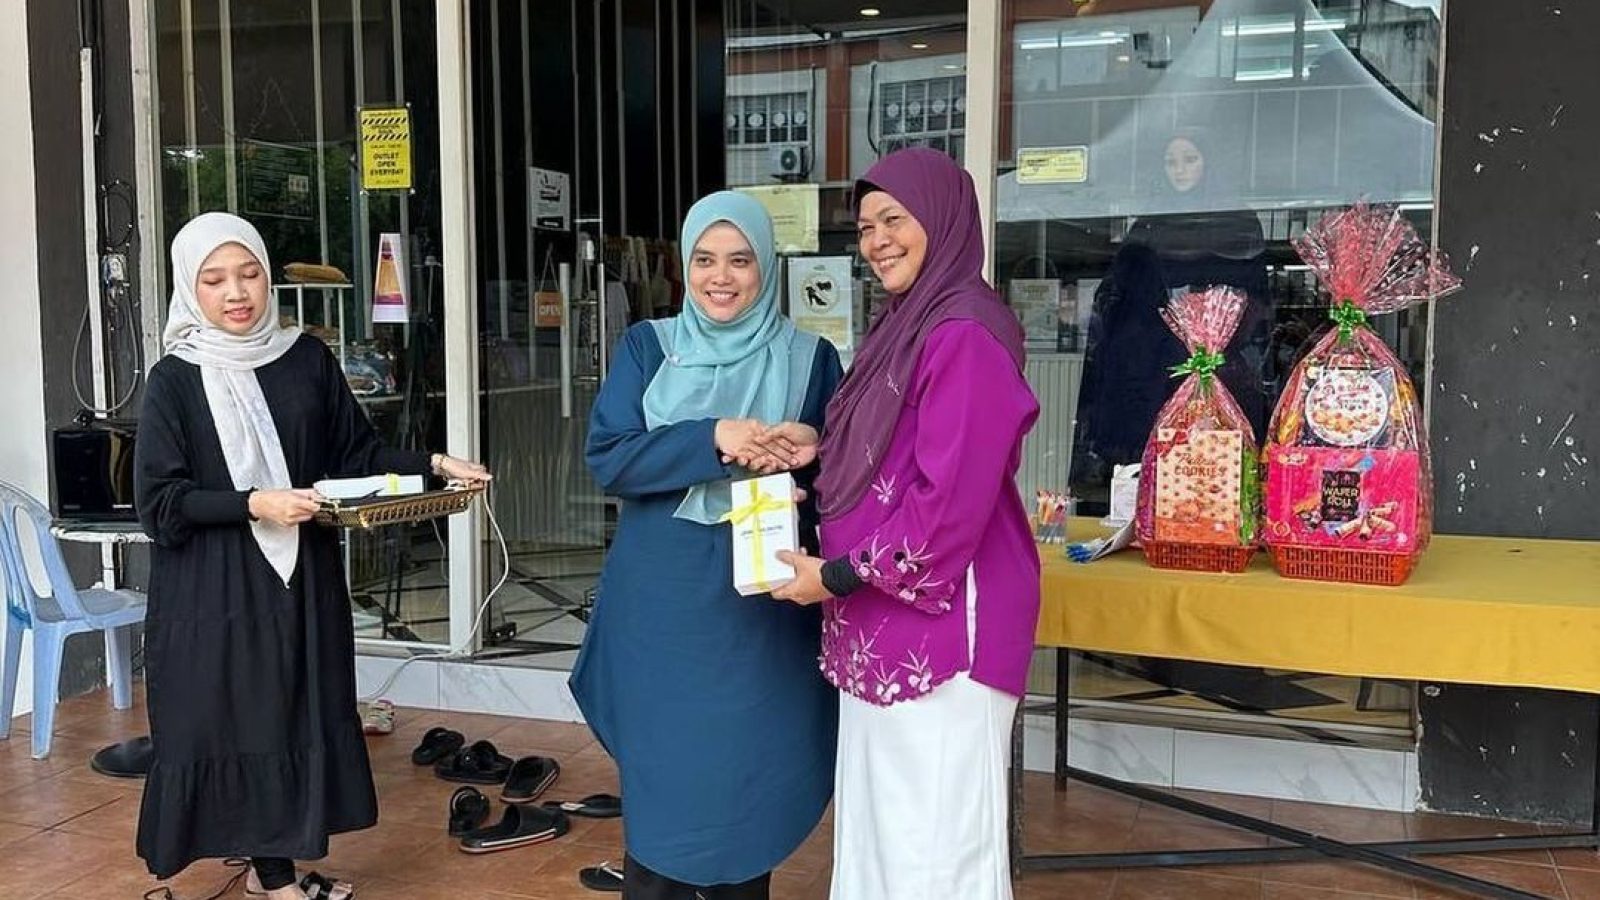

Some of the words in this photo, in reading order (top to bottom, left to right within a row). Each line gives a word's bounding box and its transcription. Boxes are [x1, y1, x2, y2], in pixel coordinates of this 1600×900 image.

[373, 153, 400, 161] OUTLET
[370, 169, 404, 177] EVERYDAY
[1174, 465, 1228, 478] COOKIES
[1322, 486, 1359, 497] WAFER
[1327, 497, 1352, 508] ROLL
